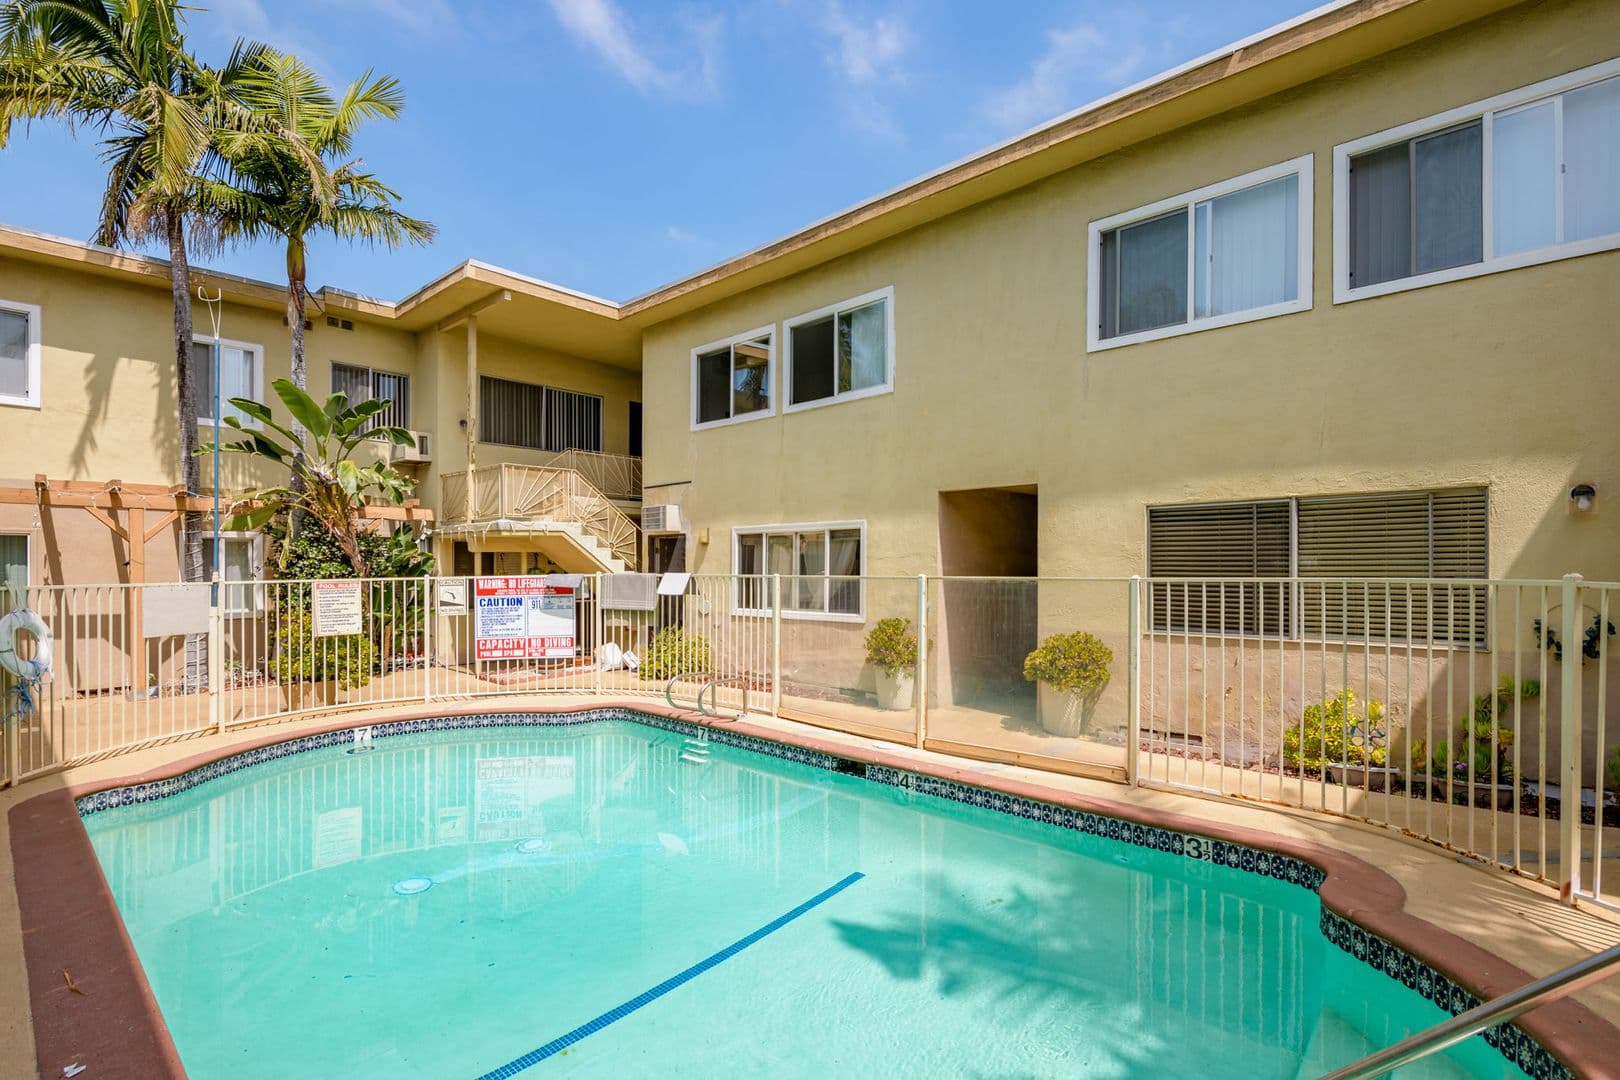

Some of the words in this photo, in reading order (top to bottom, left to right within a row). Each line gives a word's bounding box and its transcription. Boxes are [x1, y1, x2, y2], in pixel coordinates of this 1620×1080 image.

[480, 597, 523, 607] CAUTION
[531, 599, 541, 609] 911
[479, 639, 525, 650] CAPACITY
[531, 638, 542, 648] NO
[544, 636, 571, 648] DIVING
[358, 728, 368, 745] 7
